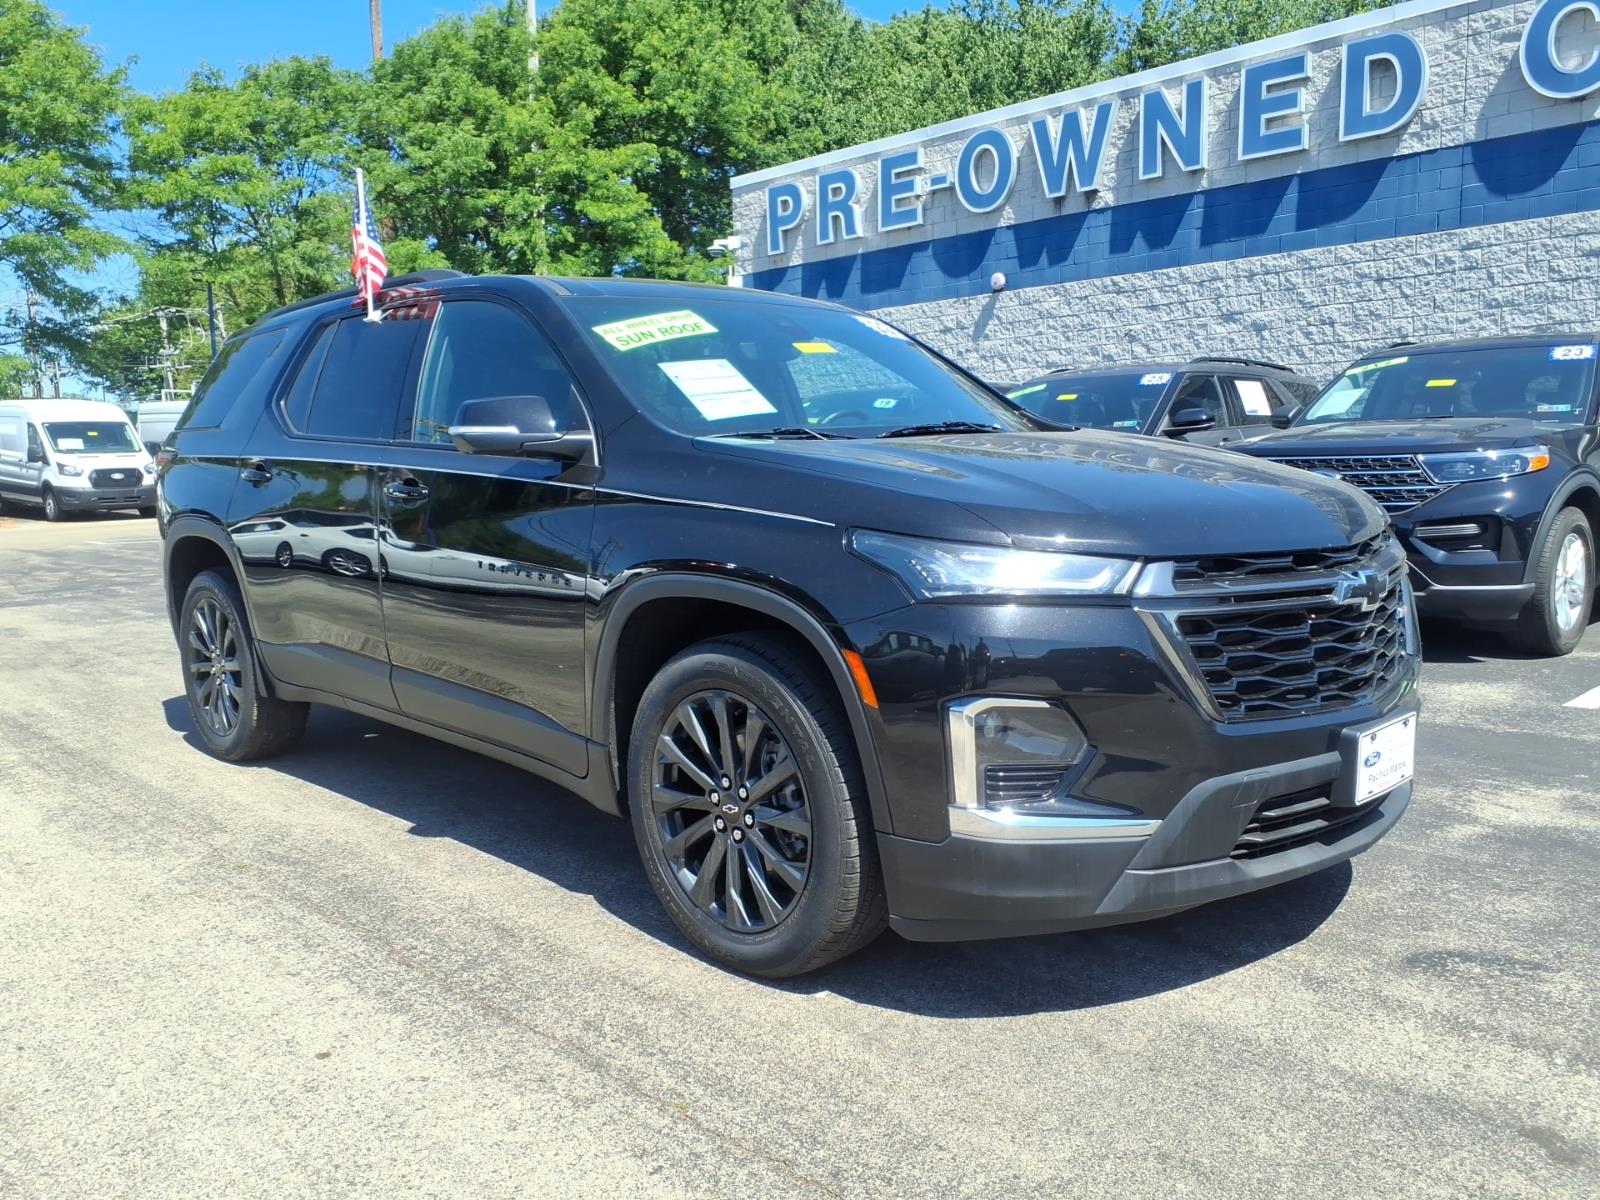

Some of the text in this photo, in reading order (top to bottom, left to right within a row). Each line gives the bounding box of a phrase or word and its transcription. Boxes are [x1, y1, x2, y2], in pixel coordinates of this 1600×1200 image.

[765, 30, 1430, 257] PRE-OWNED
[615, 321, 704, 347] SUN ROOF
[1561, 347, 1584, 357] 23
